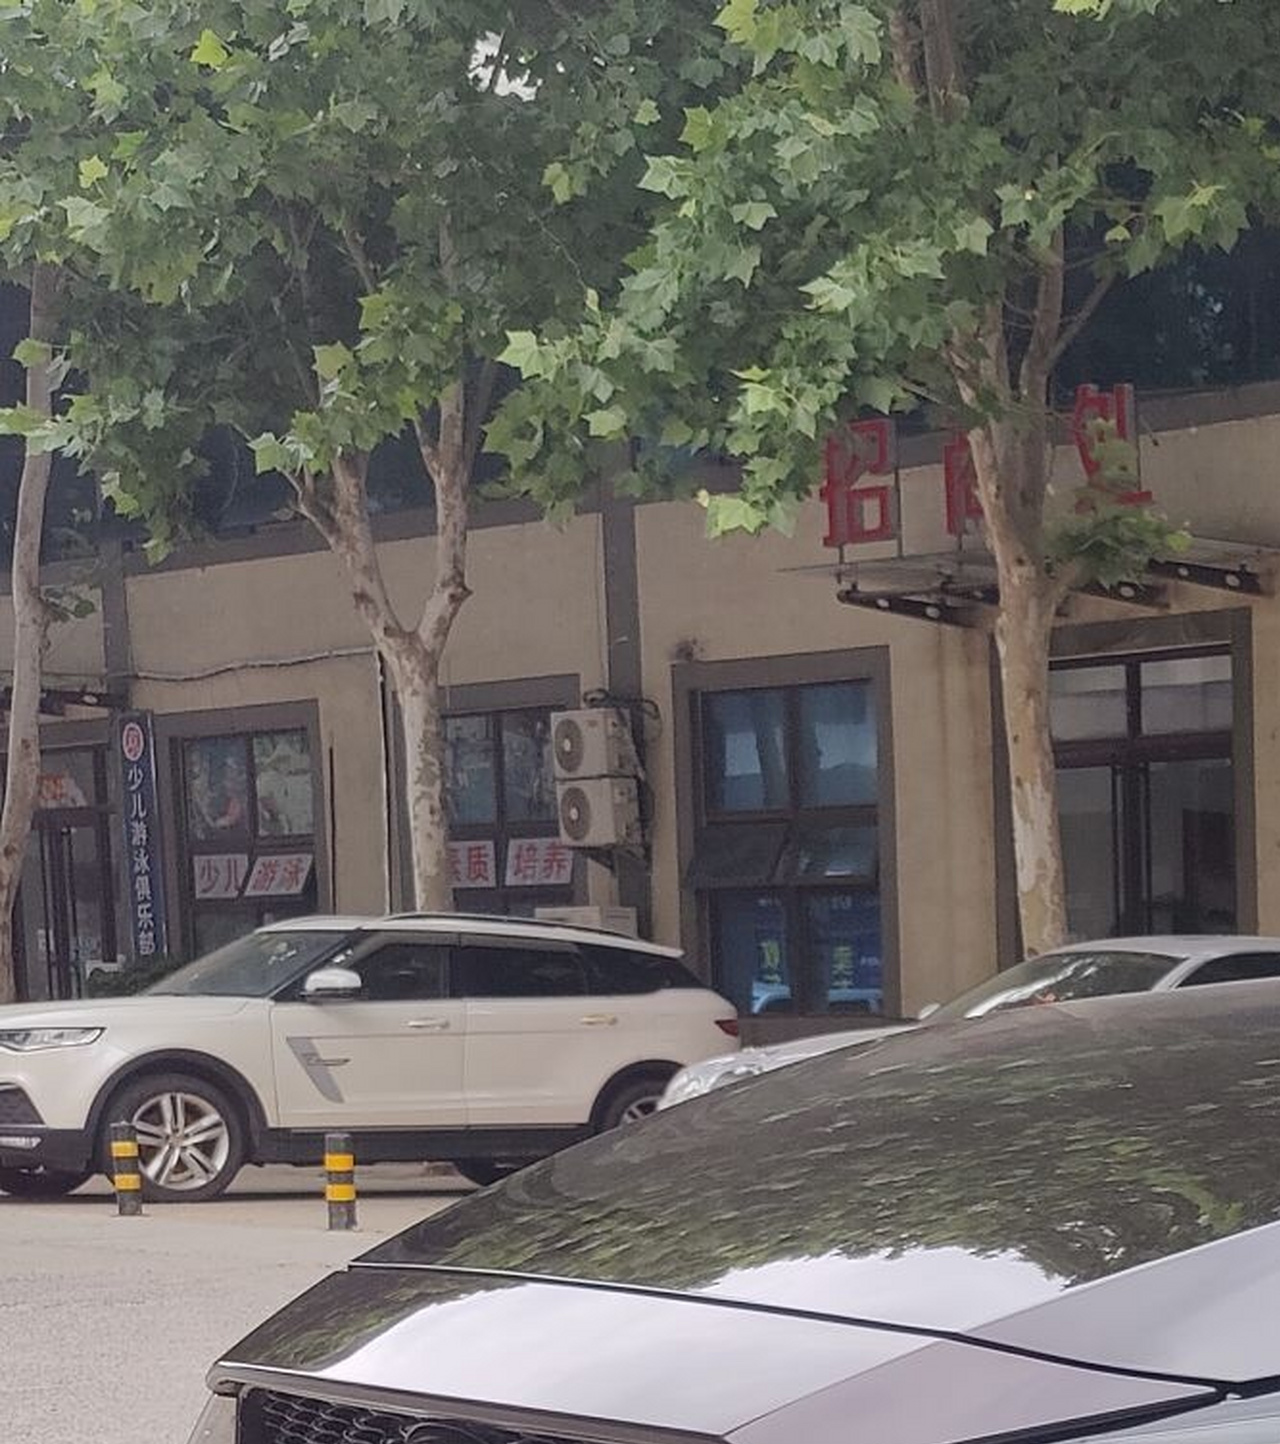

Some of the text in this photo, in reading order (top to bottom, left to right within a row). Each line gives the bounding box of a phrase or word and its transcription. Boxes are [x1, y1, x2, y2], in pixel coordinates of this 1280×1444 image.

[127, 764, 156, 956] 少儿游泳俱乐部
[514, 841, 570, 880] 培养
